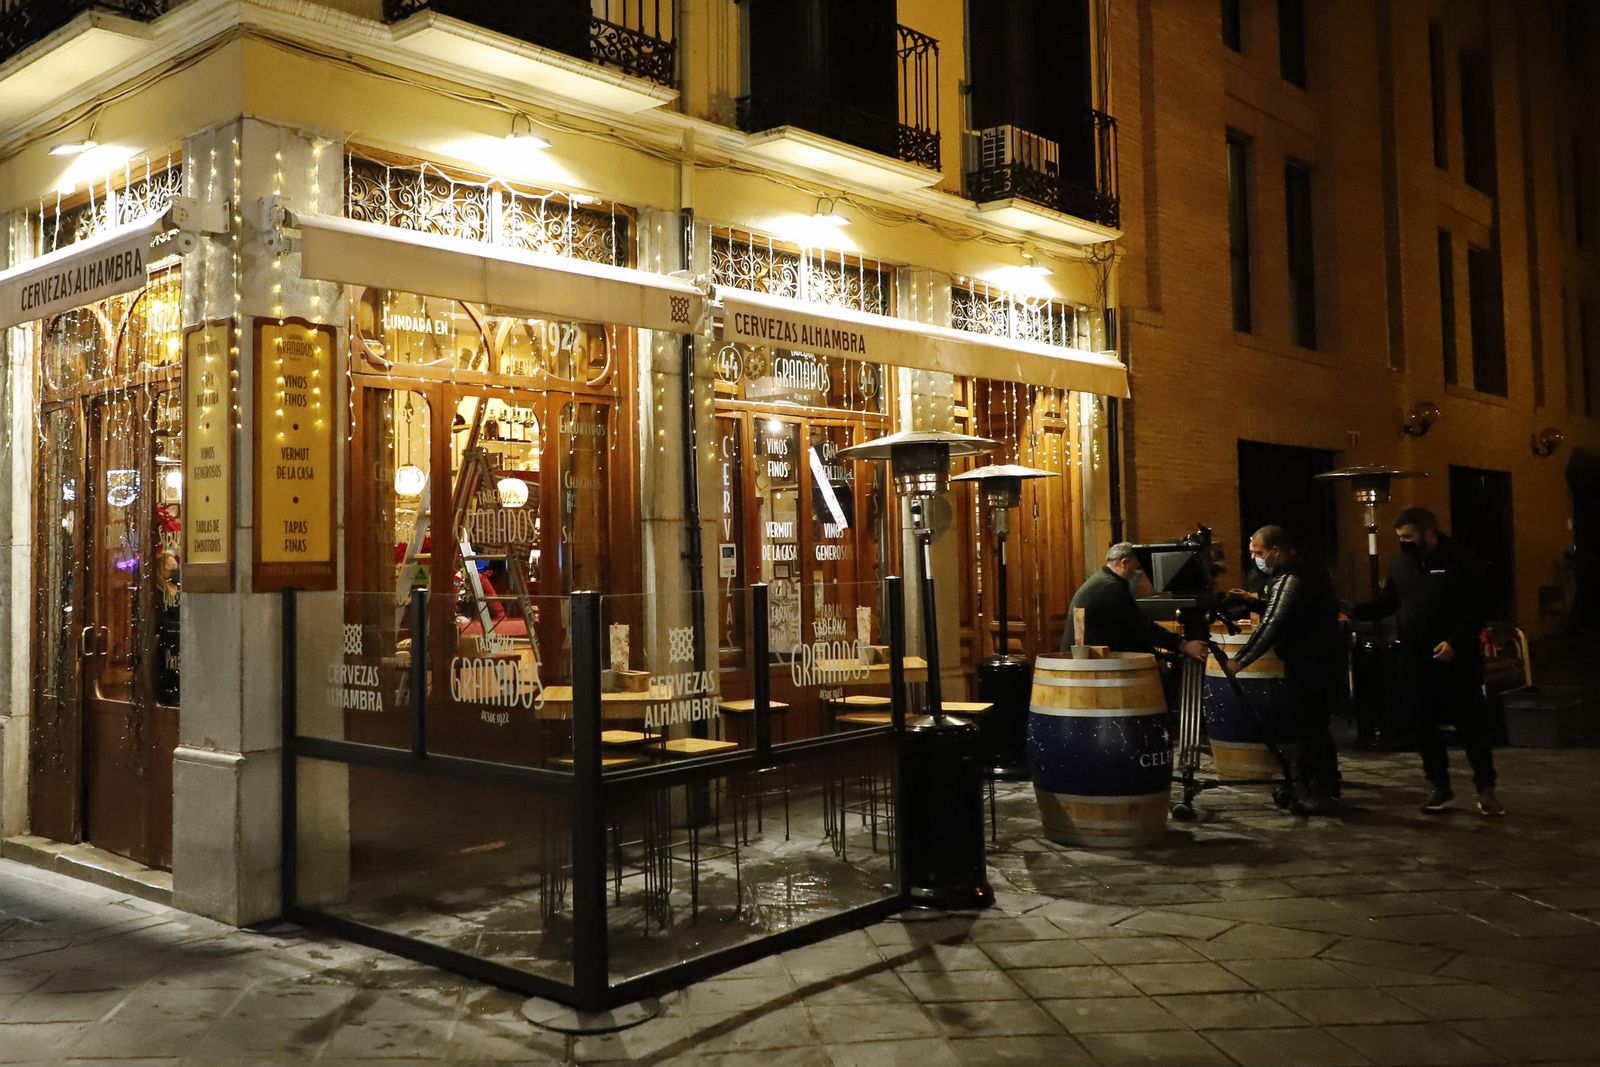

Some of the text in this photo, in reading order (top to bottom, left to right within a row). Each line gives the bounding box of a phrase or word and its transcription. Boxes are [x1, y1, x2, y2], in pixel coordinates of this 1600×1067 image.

[21, 248, 142, 311] CERVEZAS ALHAMBRA
[434, 319, 449, 336] EN
[734, 312, 866, 354] CERVEZAS ALHAMBRA
[545, 323, 582, 357] 1922
[721, 350, 739, 379] 44
[284, 376, 307, 389] VINOS
[774, 357, 831, 392] GRANADOS
[284, 394, 307, 407] FINOS
[281, 447, 309, 460] VERMUT
[766, 438, 788, 455] VINOS
[194, 464, 221, 480] GENEROSOS
[277, 466, 314, 480] DE LA CASA
[767, 461, 789, 478] FINOS
[196, 519, 219, 533] TABLAS DE
[284, 521, 308, 534] TAPAS
[453, 508, 539, 545] GRANADOS
[765, 522, 793, 538] VERMUT
[824, 523, 844, 539] VINOS
[194, 539, 221, 553] EMBUTIDOS
[284, 539, 307, 552] FINAS
[722, 435, 733, 647] CERVZAS
[762, 544, 798, 561] DE LA CASA
[811, 617, 847, 638] TABERNA
[475, 633, 515, 654] TABERNA
[791, 639, 870, 688] GRANADOS
[327, 664, 379, 687] CERVEZAS
[450, 656, 545, 711] GRANADOS
[647, 670, 715, 699] CERVEZAS
[326, 688, 383, 713] ALHAMBRA
[644, 697, 721, 729] ALHAMBRA
